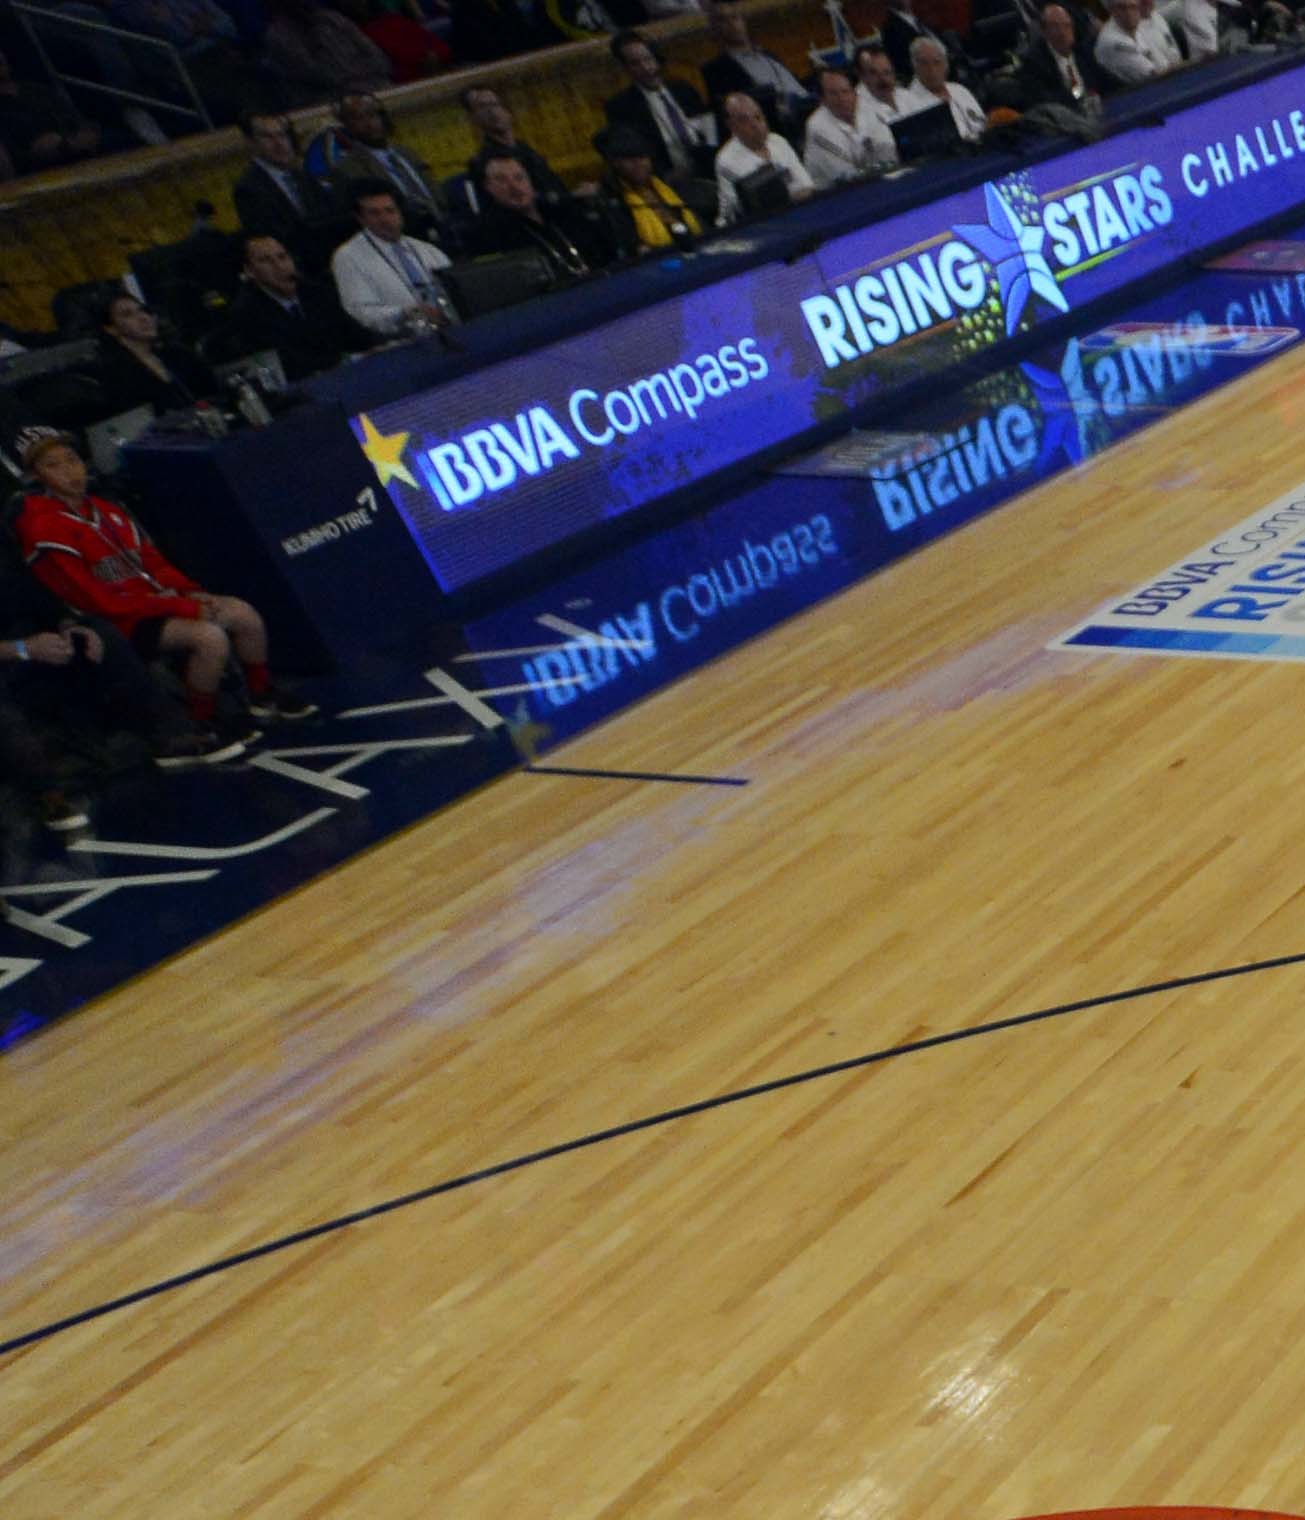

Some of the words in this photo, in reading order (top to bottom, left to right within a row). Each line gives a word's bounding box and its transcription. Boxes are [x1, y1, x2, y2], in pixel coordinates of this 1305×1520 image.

[801, 241, 988, 368] RISING
[1043, 165, 1173, 268] STARS
[424, 406, 580, 512] BBVA
[568, 337, 769, 446] Compass
[1111, 560, 1235, 617] BBVA
